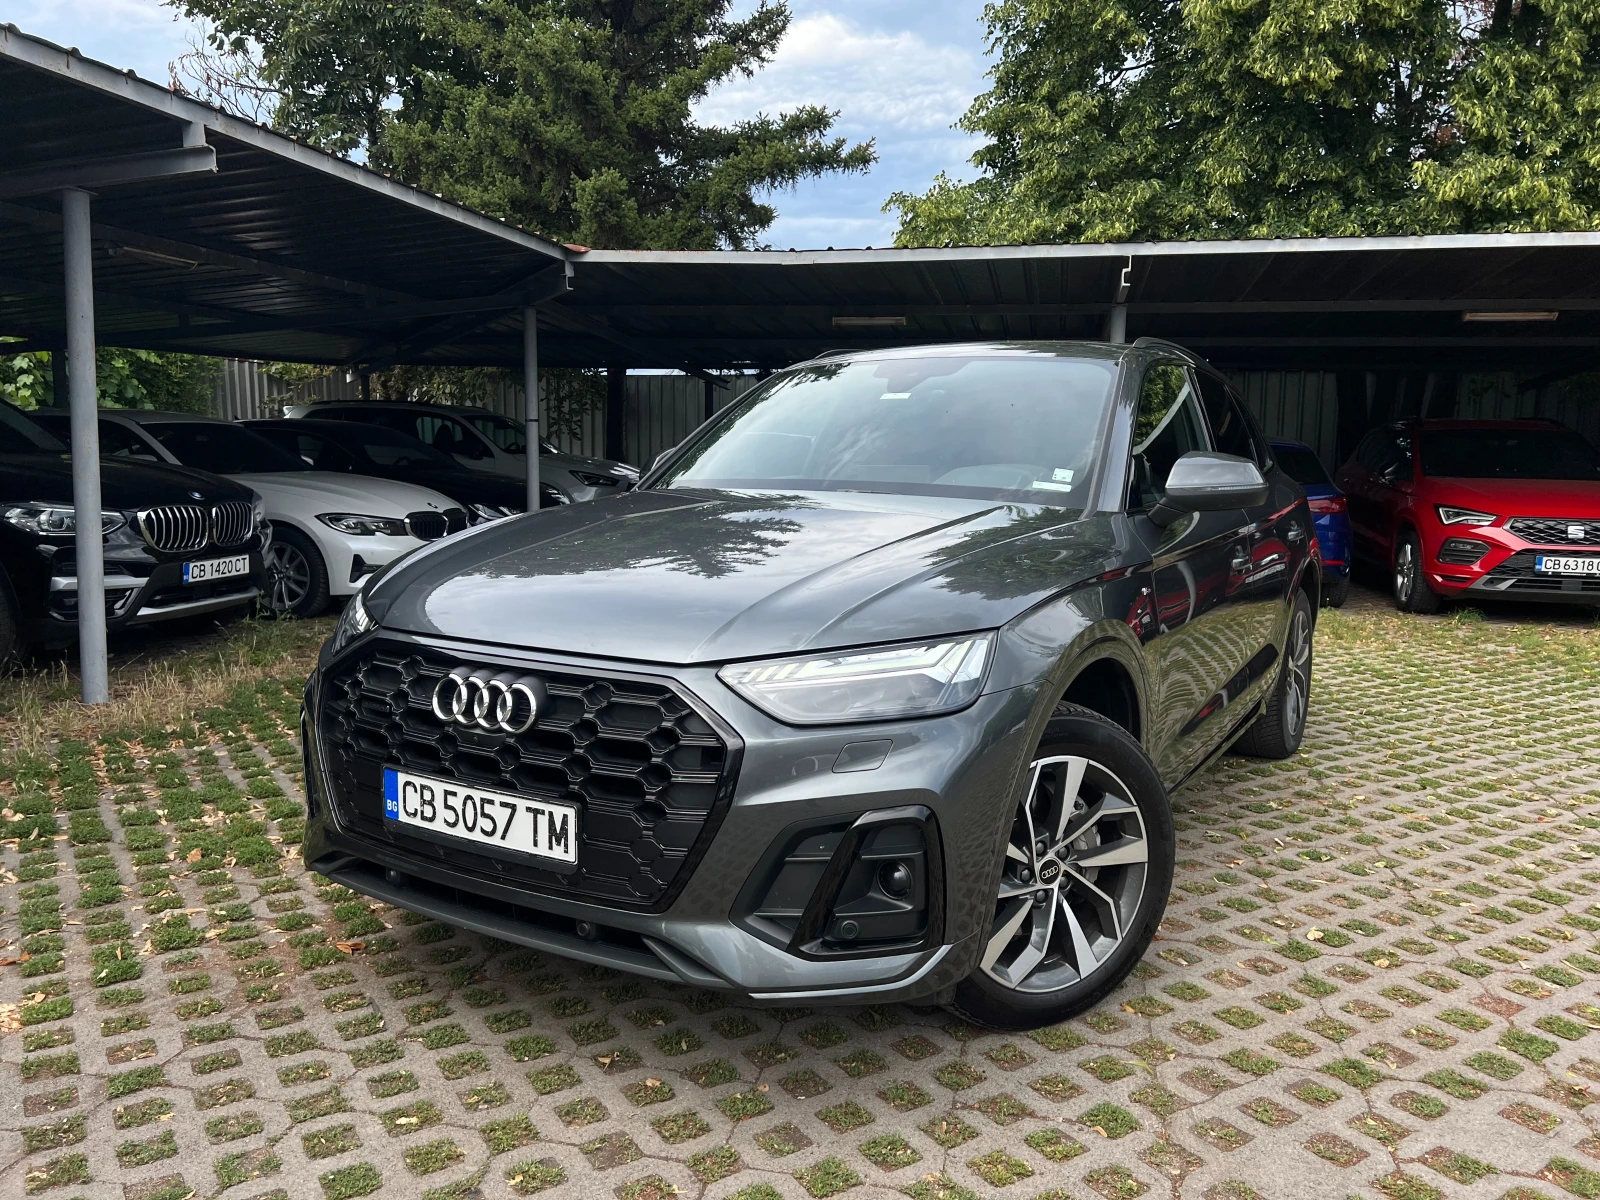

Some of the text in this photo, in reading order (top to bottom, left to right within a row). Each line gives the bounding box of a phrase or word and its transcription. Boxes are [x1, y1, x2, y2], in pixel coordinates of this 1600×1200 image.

[191, 557, 247, 579] CB 1420 CT
[1544, 558, 1561, 570] CB
[1563, 559, 1594, 571] 6318
[386, 799, 398, 812] BG
[402, 780, 569, 854] CB 5057 TM
